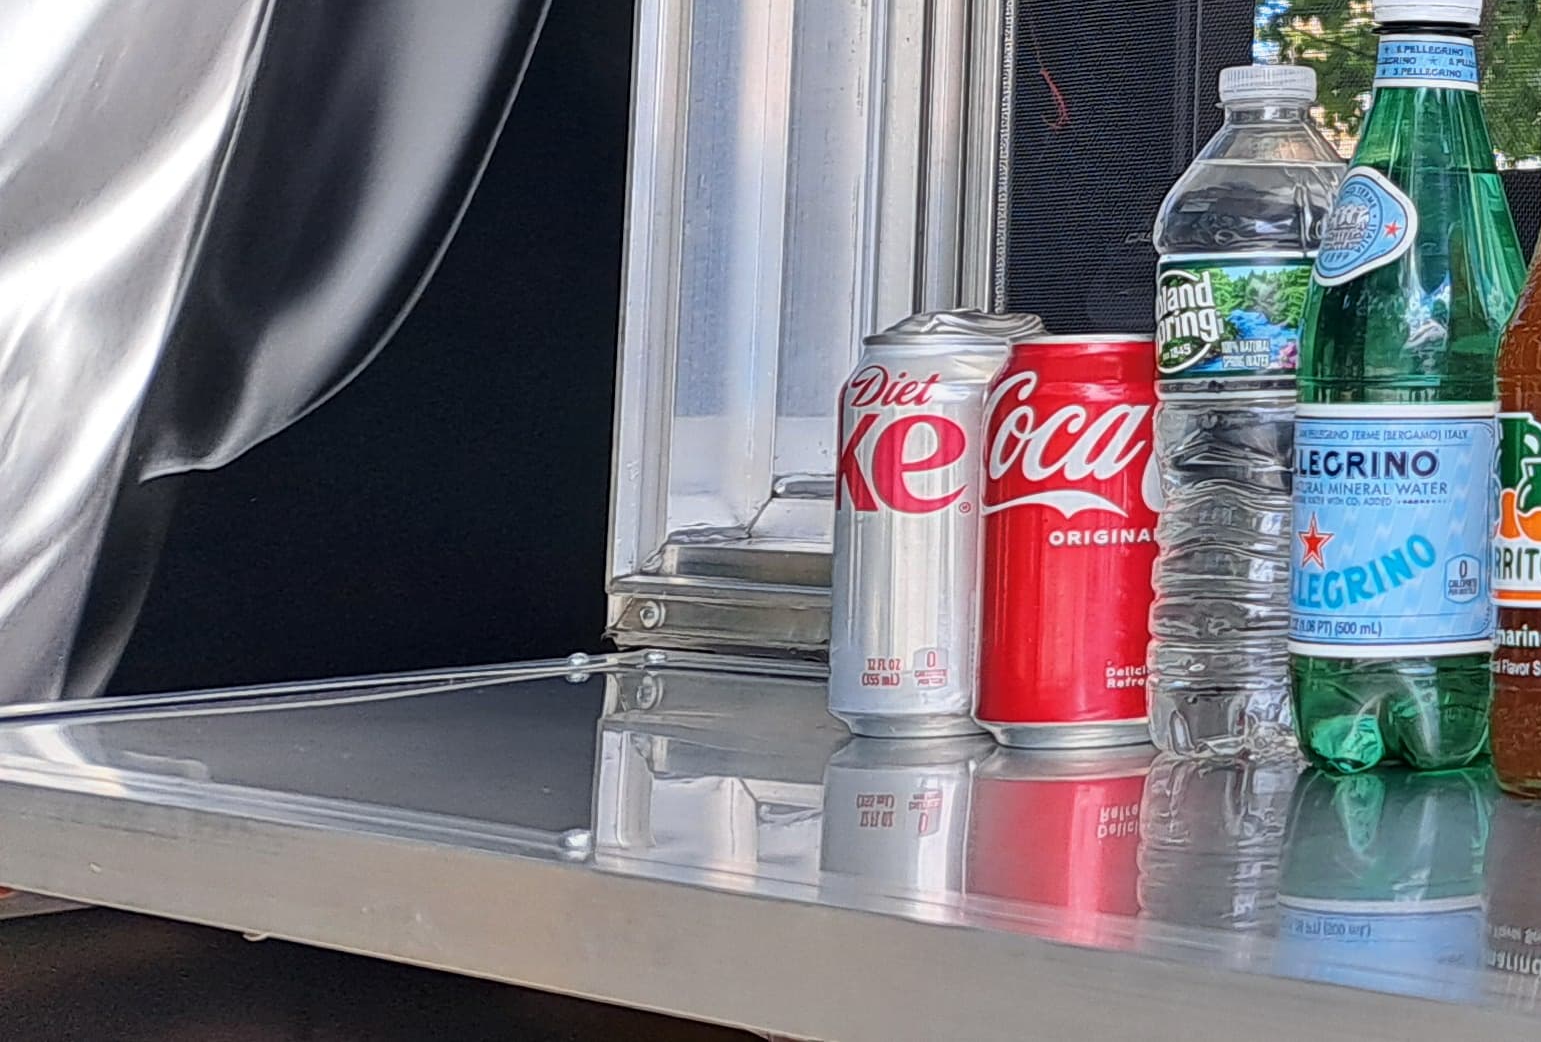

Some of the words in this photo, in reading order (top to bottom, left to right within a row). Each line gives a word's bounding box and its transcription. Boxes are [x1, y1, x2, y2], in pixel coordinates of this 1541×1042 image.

[850, 365, 941, 407] Diet
[982, 370, 1163, 517] Coca
[1445, 430, 1468, 440] ITALY
[1294, 449, 1438, 479] LEGRINO
[1328, 482, 1390, 496] MINERAL
[1395, 482, 1448, 495] WATER
[1295, 534, 1437, 608] LEGRINO
[1460, 559, 1468, 579] 0
[1335, 621, 1356, 636] (500
[1359, 621, 1383, 637] mL)
[926, 650, 936, 668] 0
[1502, 659, 1530, 675] Flavor
